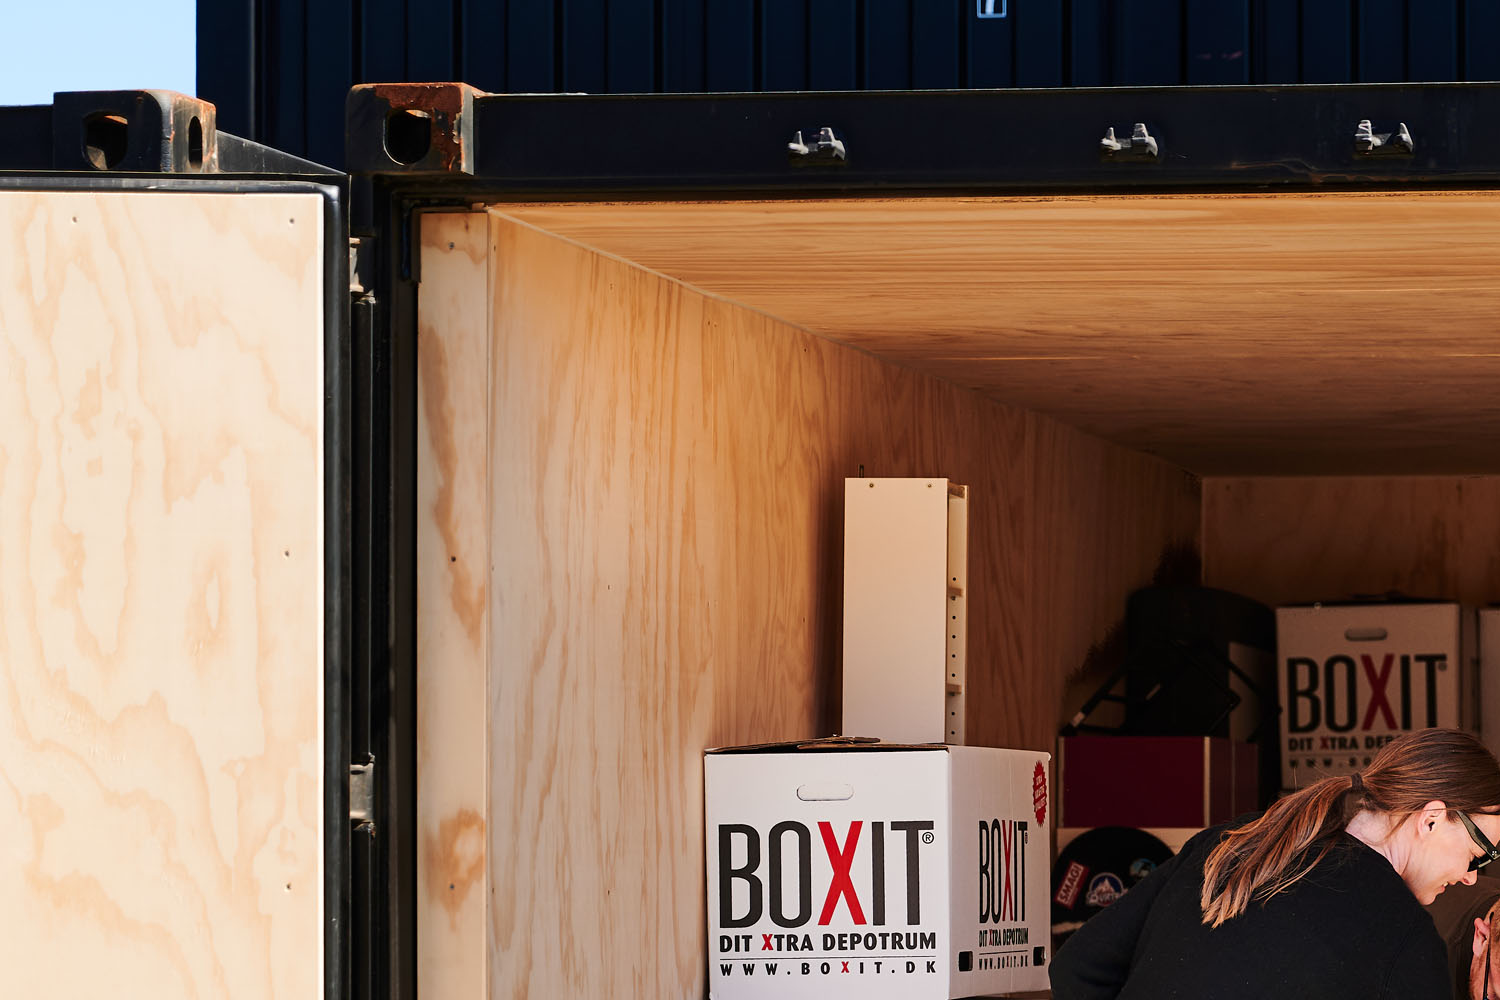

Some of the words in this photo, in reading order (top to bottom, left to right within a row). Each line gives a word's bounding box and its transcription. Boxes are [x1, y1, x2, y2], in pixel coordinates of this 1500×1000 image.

[1288, 738, 1313, 751] DIT
[1320, 736, 1358, 750] XTRA
[720, 935, 752, 952] DIT
[762, 934, 813, 951] XTRA
[823, 932, 935, 951] DEPOTRUM
[979, 930, 987, 947] DIT
[989, 929, 1001, 946] XTRA
[1003, 928, 1028, 945] DEPOTRUM
